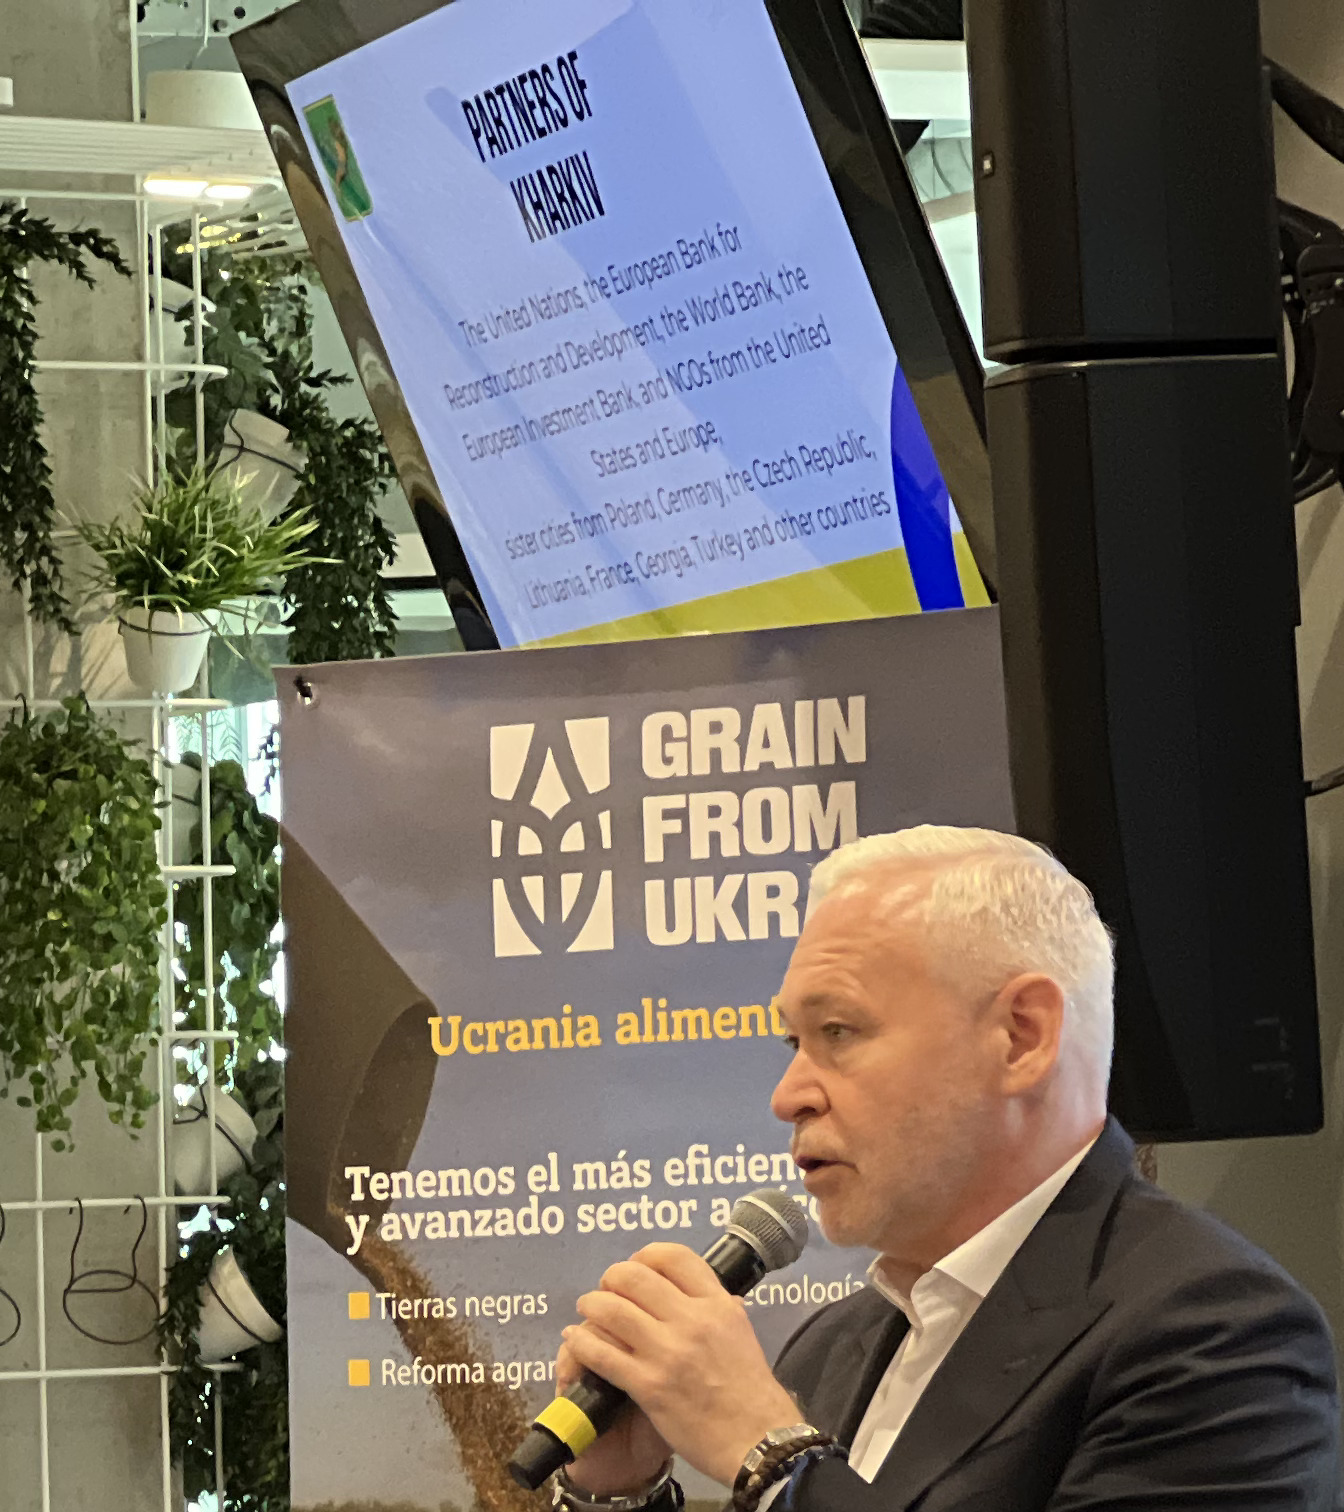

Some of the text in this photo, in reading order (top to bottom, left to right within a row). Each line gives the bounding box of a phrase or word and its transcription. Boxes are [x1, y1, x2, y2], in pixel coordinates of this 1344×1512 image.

[461, 49, 593, 163] PARTNERS OF
[509, 150, 605, 243] KHARKIV
[458, 222, 743, 348] The United Nations, the European Bank for
[444, 359, 542, 410] Reconstruction
[539, 343, 568, 379] and
[660, 304, 690, 338] the
[684, 284, 736, 328] World
[732, 271, 783, 312] Bank,
[778, 264, 809, 296] the
[462, 423, 526, 462] European
[521, 398, 601, 442] Investment
[638, 368, 668, 405] and
[708, 350, 750, 381] from
[746, 336, 777, 369] the
[773, 312, 832, 358] United
[591, 421, 723, 478] States and Europe,
[505, 530, 538, 560] sister
[539, 518, 576, 550] cities
[570, 511, 608, 540] from
[605, 491, 662, 531] Poland,
[725, 463, 755, 497] the
[752, 448, 802, 488] Czech
[798, 428, 878, 477] Republic,
[585, 561, 641, 594] France,
[690, 528, 745, 561] Turkey
[743, 514, 775, 551] and
[774, 508, 816, 543] other
[816, 486, 891, 531] countries
[641, 695, 867, 780] GRAIN
[642, 780, 858, 863] FROM
[644, 868, 811, 947] UKR
[427, 1003, 602, 1057] Ucrania
[344, 1165, 515, 1201] Tenemos
[526, 1152, 560, 1193] el
[572, 1149, 651, 1191] más
[345, 1211, 371, 1257] y
[380, 1195, 565, 1242] avanzado
[576, 1194, 699, 1235] sector
[375, 1291, 457, 1320] Tierras
[464, 1293, 549, 1324] negras
[381, 1356, 485, 1386] Reforma
